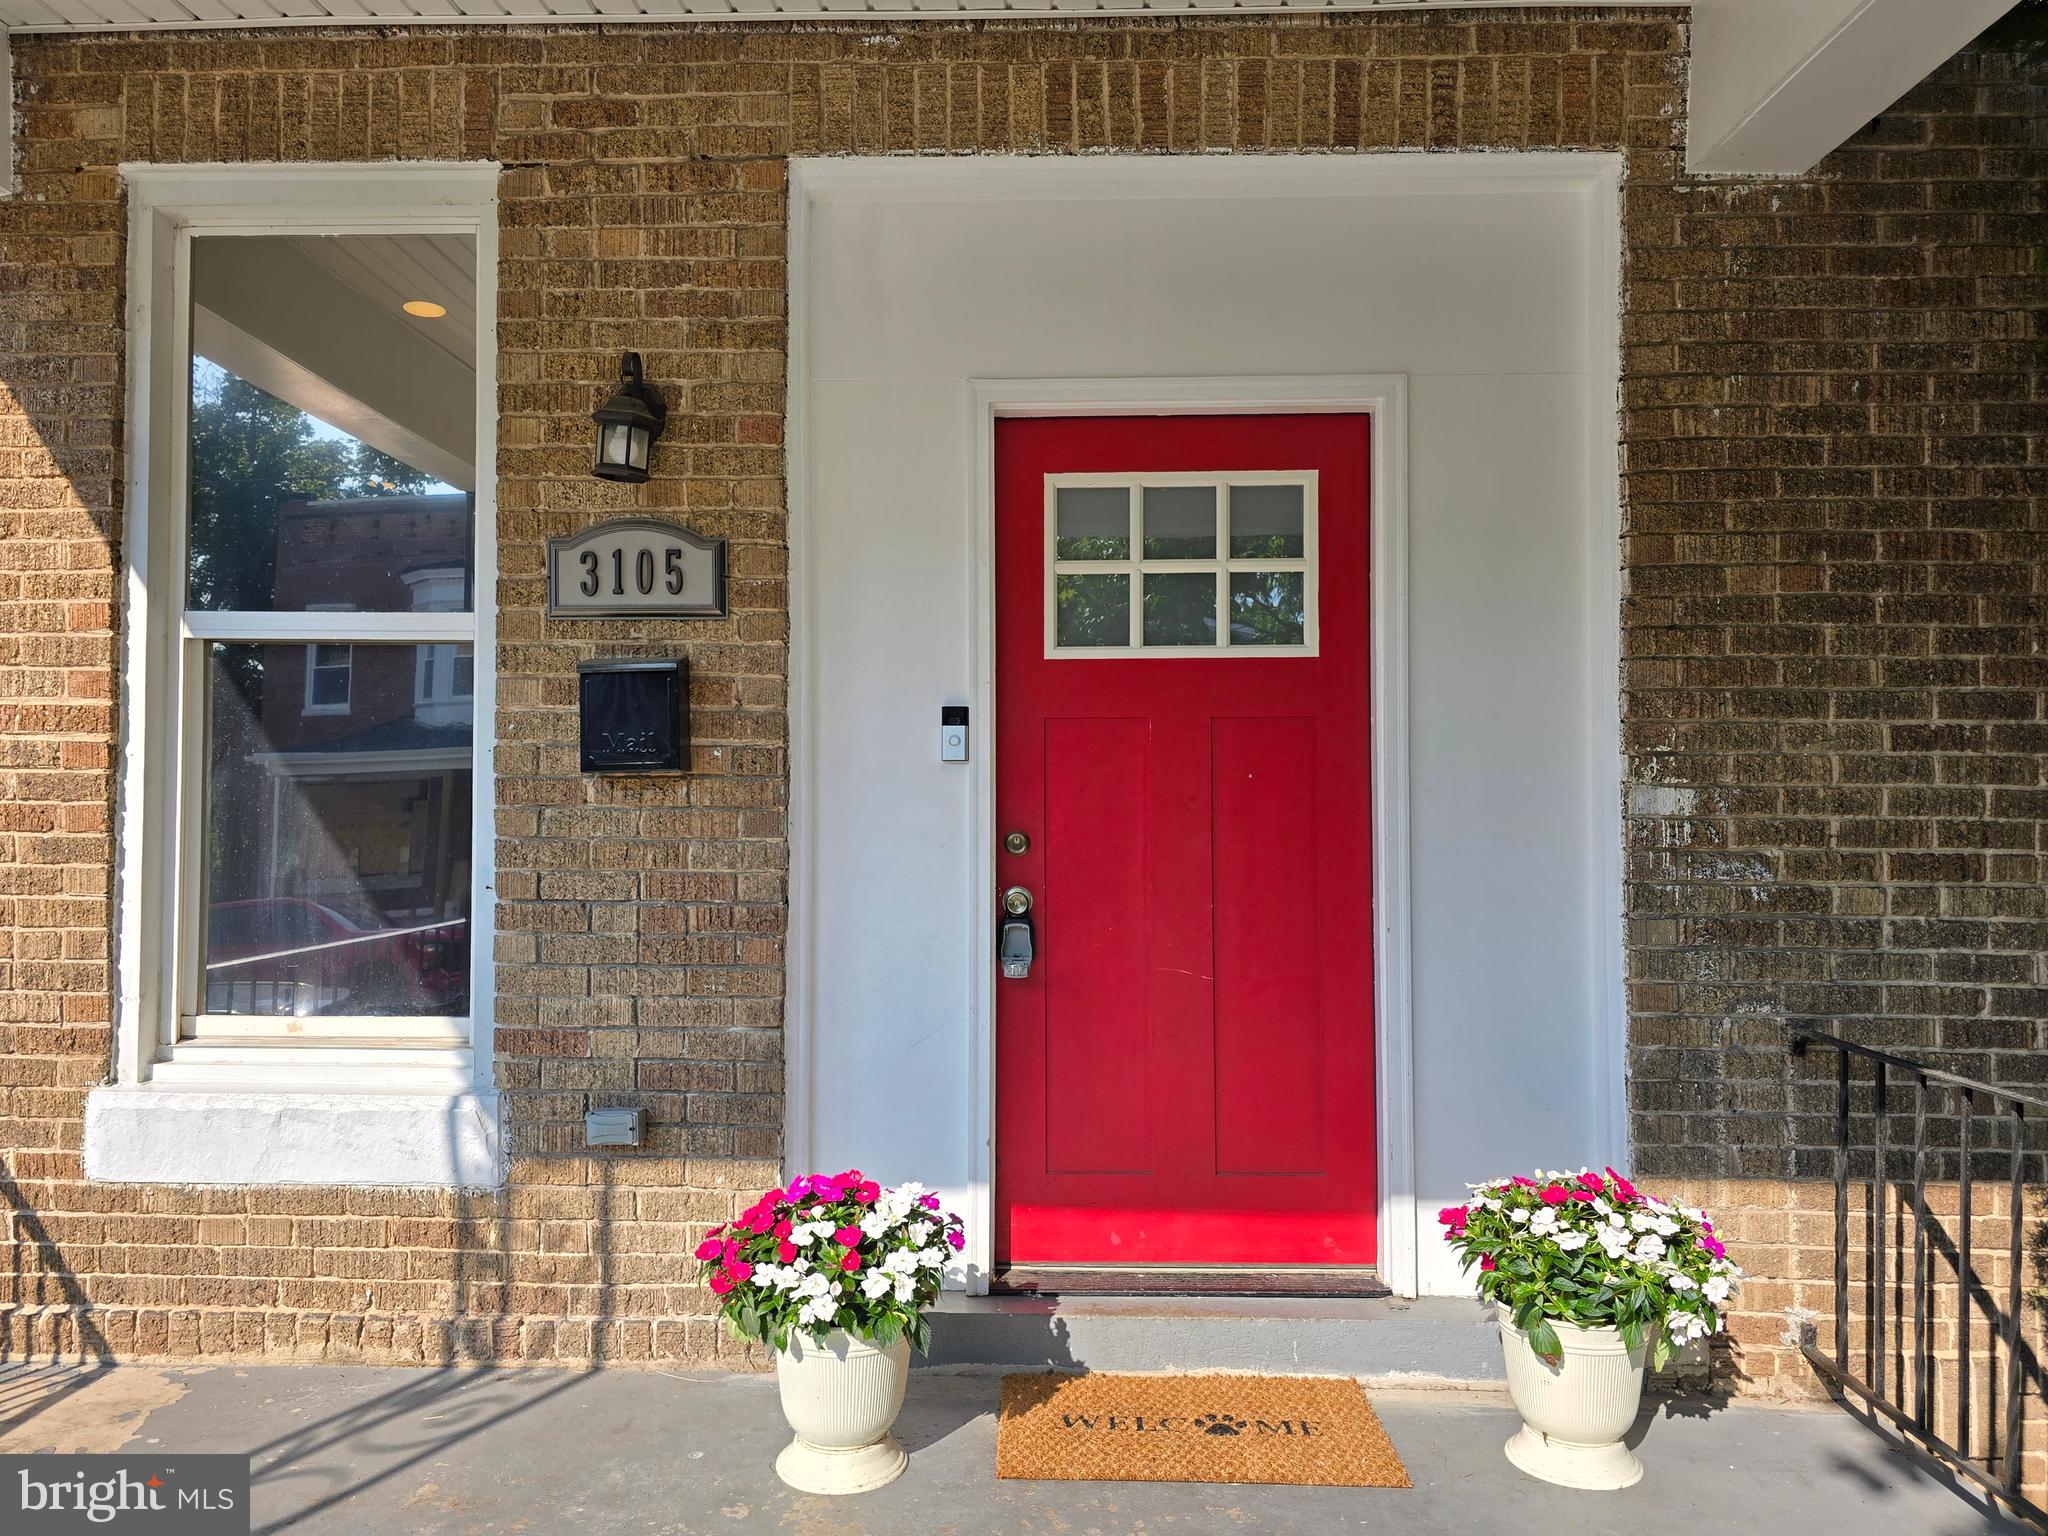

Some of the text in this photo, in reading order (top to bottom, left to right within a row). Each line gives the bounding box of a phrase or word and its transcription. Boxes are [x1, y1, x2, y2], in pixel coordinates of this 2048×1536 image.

[579, 548, 684, 597] 3105
[601, 731, 657, 753] Mail
[1061, 1413, 1325, 1437] WELCME
